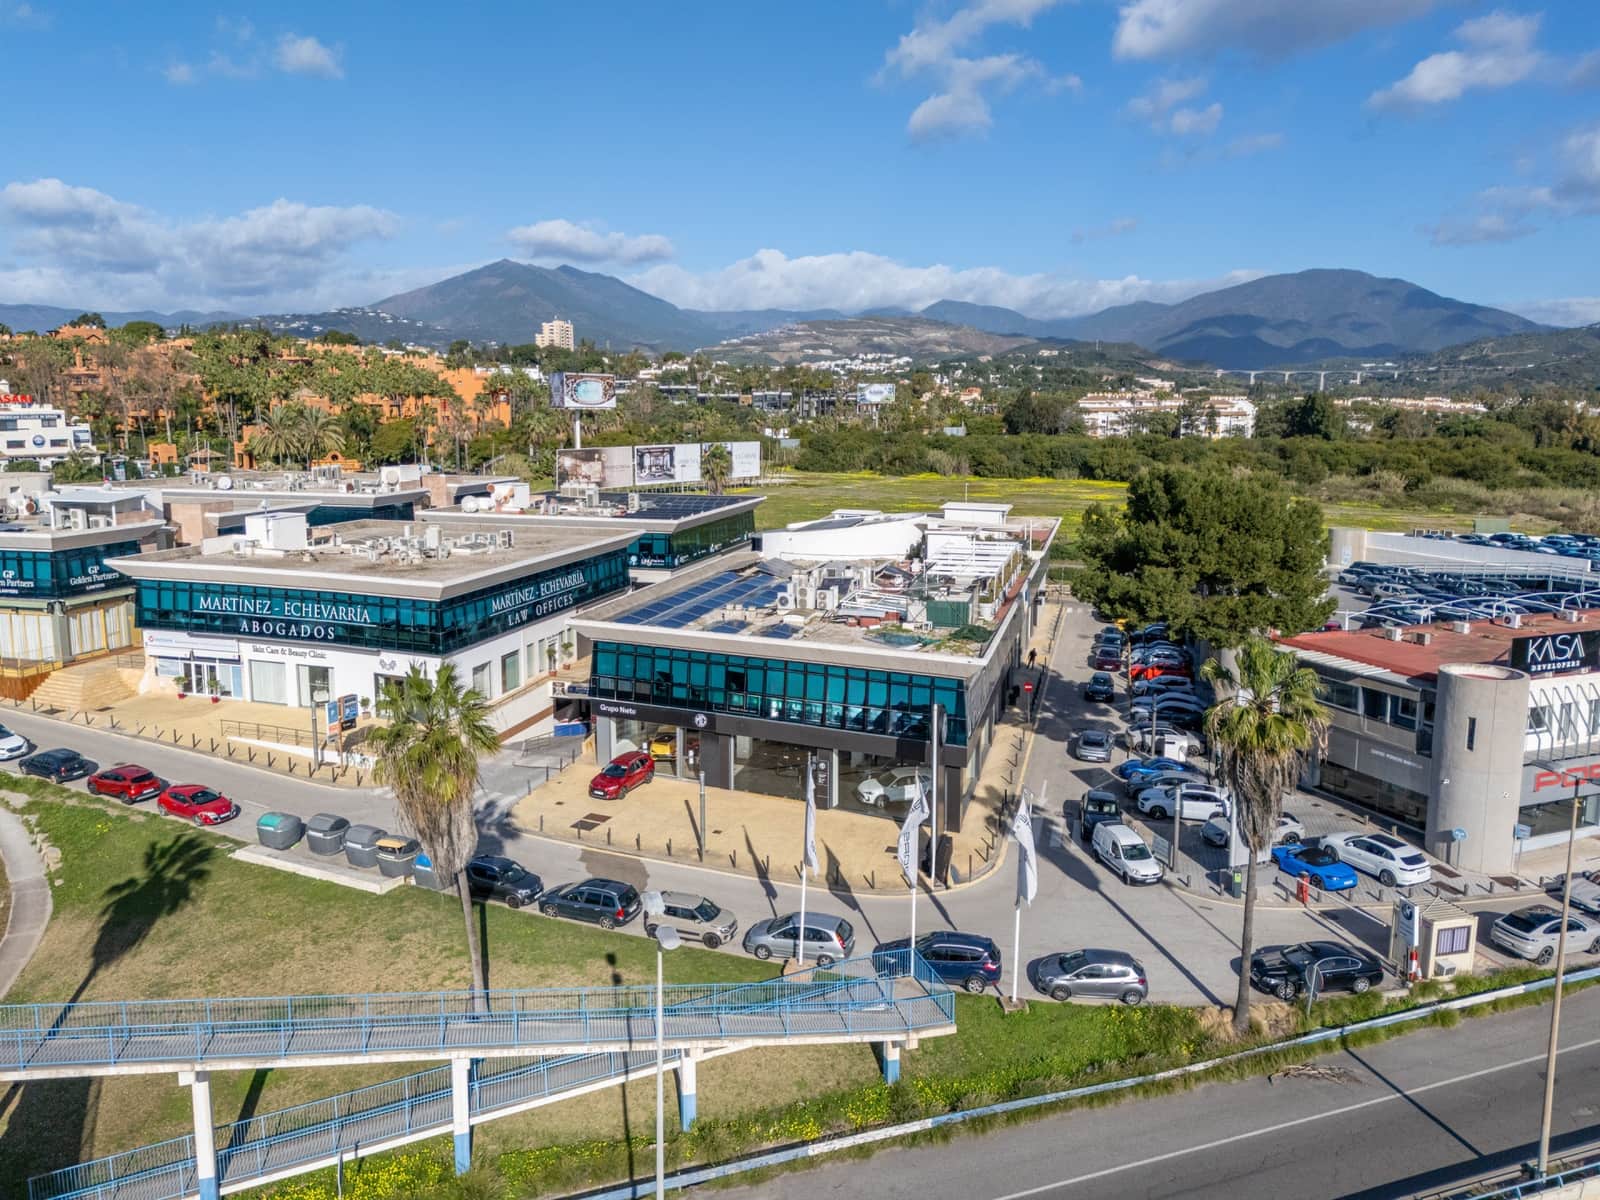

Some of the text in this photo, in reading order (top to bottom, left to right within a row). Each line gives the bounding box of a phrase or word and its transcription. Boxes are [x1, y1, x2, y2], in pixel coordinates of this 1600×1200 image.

[0, 393, 33, 403] SARI
[492, 586, 536, 613] MARTÍNEZ
[540, 570, 585, 598] ECHEVARRÍA
[199, 595, 272, 615] MARTÍNEZ
[284, 601, 371, 623] ECHEVARRÍA
[508, 593, 574, 625] LAW OFFICES
[240, 619, 335, 640] ABOGADOS
[1527, 634, 1585, 663] KASA
